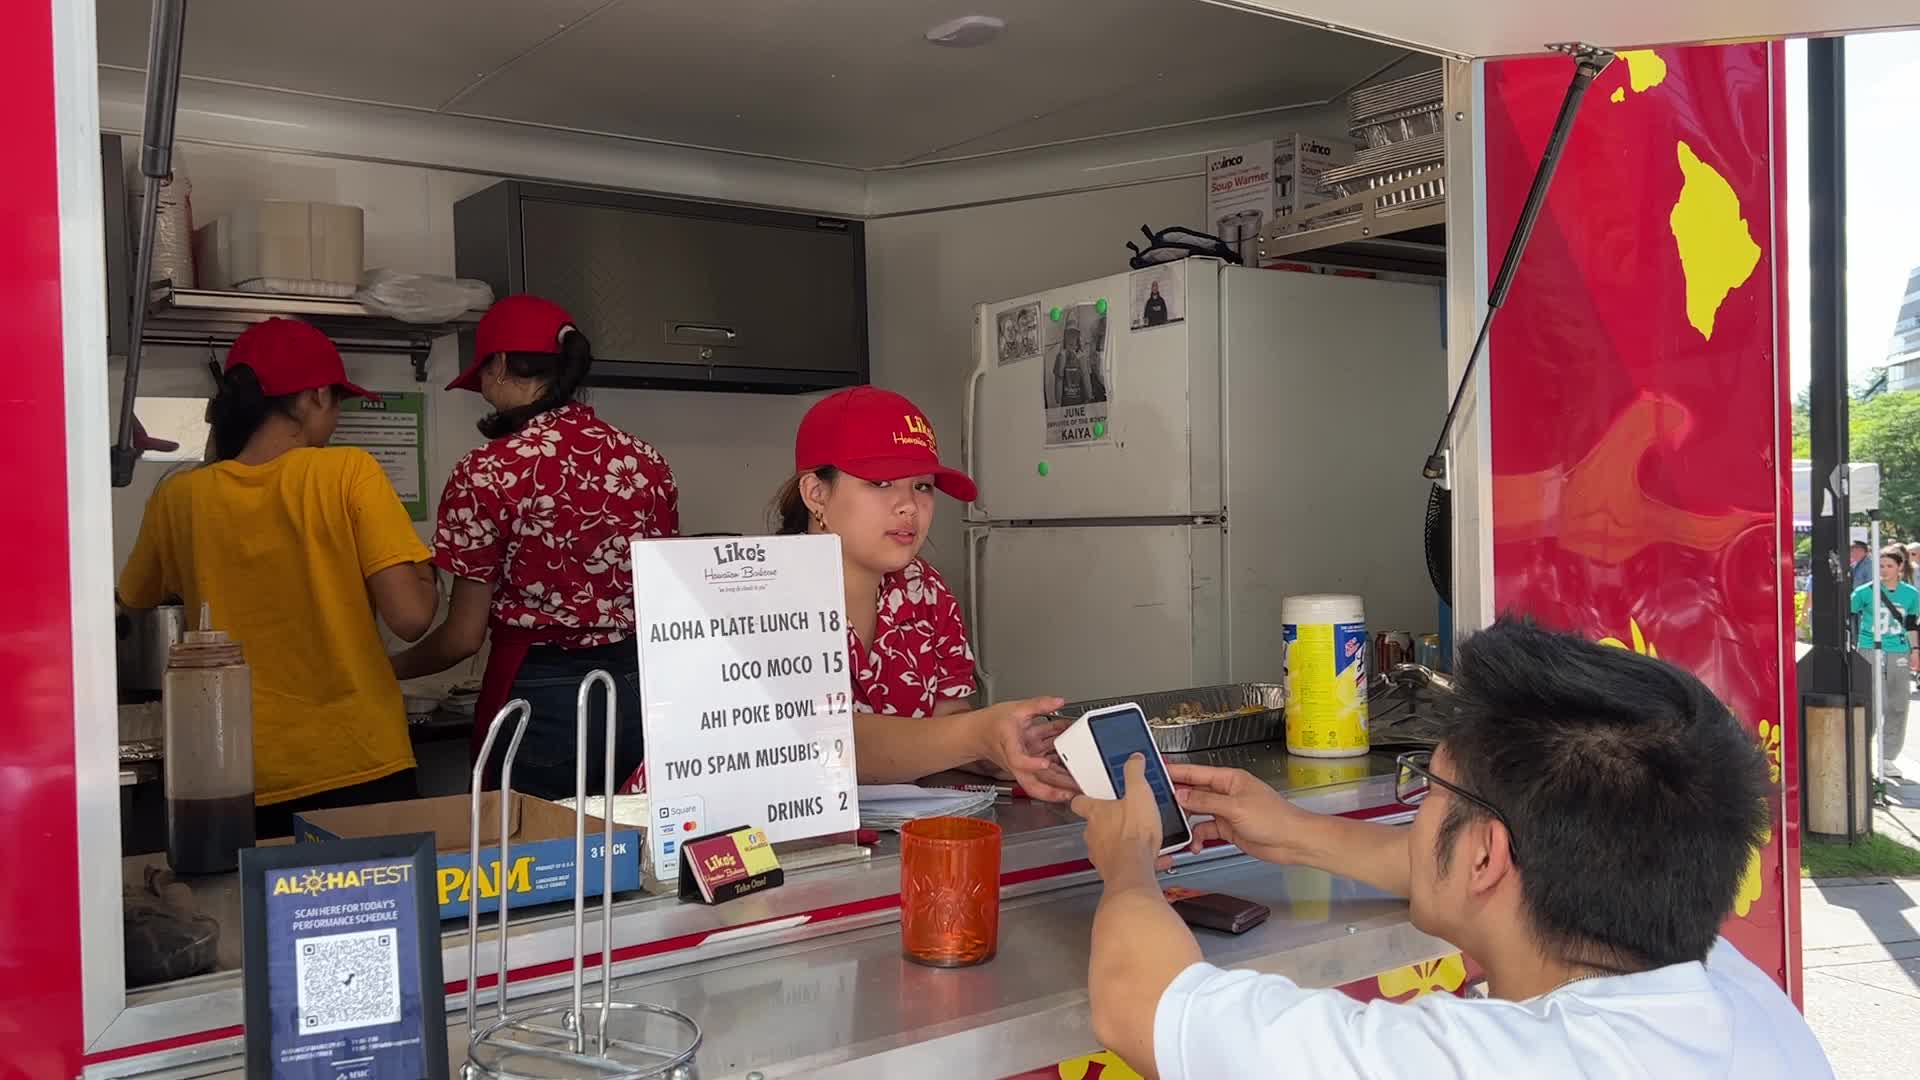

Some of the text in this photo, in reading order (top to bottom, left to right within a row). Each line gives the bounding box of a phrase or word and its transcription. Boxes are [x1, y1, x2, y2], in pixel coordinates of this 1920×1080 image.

[1211, 171, 1269, 192] Soup Warmer
[1064, 407, 1086, 418] JUNE
[1062, 427, 1091, 440] KAIYA
[713, 542, 766, 565] Liko's
[650, 610, 840, 643] ALOHA PLATE LUNCH 18
[722, 651, 843, 682] LOCO MOCO 15
[700, 692, 847, 730] AHI POKE BOWL 12
[666, 739, 844, 780] TWO SPAM MUSUBIS 9
[671, 805, 697, 816] Square
[767, 791, 848, 822] DRINKS 2
[591, 843, 627, 858] 3 PCK
[704, 853, 736, 872] Liko's
[272, 864, 413, 896] ALOHAFEST
[437, 856, 532, 905] PAM
[735, 883, 751, 895] Take
[294, 899, 396, 919] SCAN HERE FOR TODAY'S
[293, 910, 399, 931] PERFORMANCE SCHEDULE
